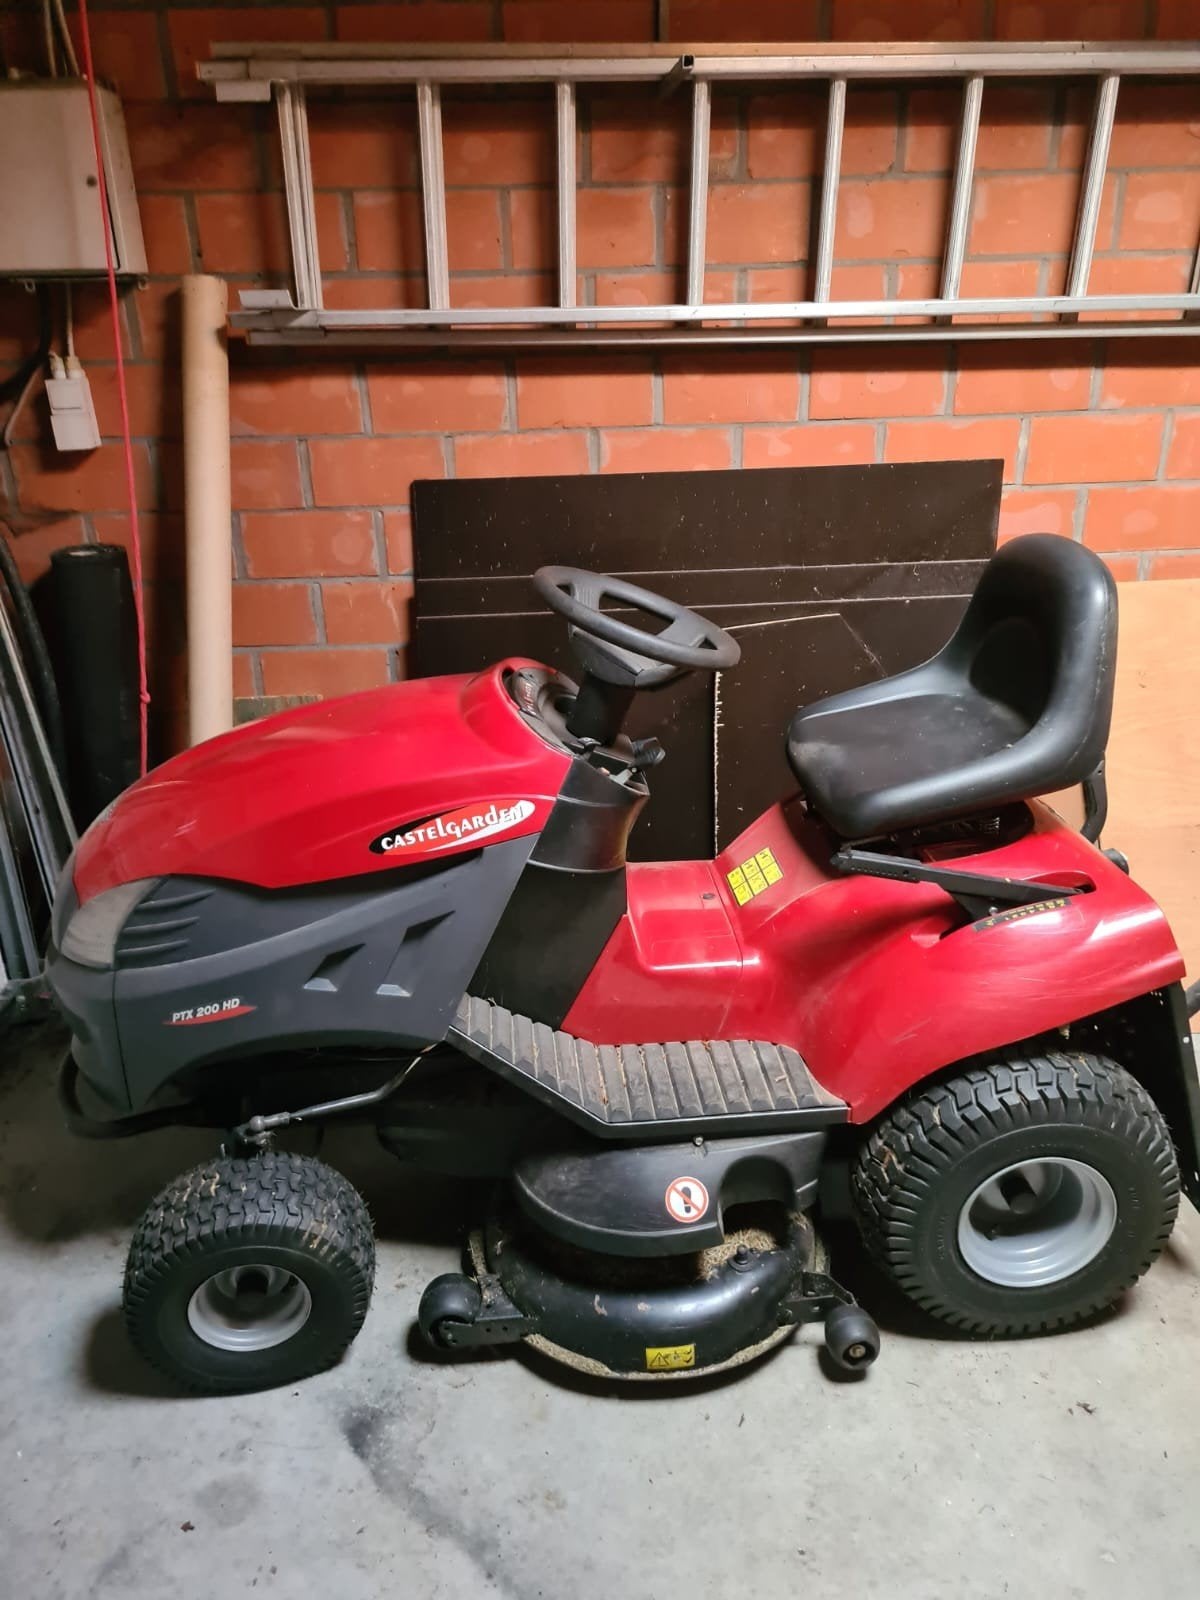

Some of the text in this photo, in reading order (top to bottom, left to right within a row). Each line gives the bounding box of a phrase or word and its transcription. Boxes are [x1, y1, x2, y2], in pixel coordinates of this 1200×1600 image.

[172, 998, 240, 1022] PTX 200 HD
